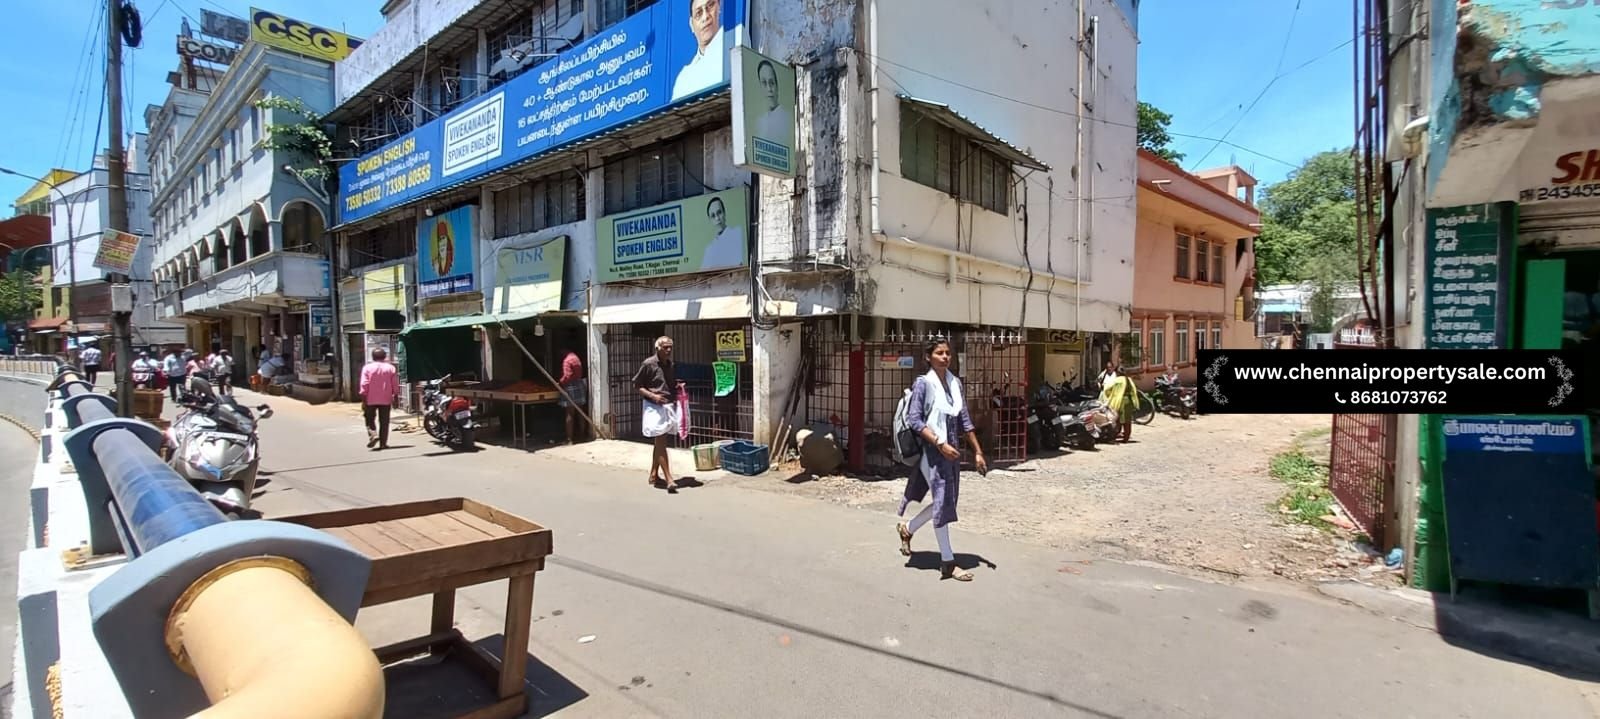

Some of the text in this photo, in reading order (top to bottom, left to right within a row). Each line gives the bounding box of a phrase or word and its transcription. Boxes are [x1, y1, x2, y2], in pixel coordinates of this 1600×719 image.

[254, 11, 338, 54] CSC
[523, 95, 536, 108] 40
[595, 41, 647, 75] அனுபவம்
[518, 117, 526, 129] 16
[578, 61, 652, 103] மேற்பட்டவர்கள்
[449, 108, 497, 141] VIVEKANANDA
[357, 153, 383, 176] SPOKEN
[384, 137, 416, 165] ENGLISH
[448, 132, 496, 163] SPOKEN ENGLISH
[617, 212, 677, 237] VIVEKANANDA
[617, 236, 678, 258] SPOKEN ENGLISH
[719, 332, 740, 346] CSC
